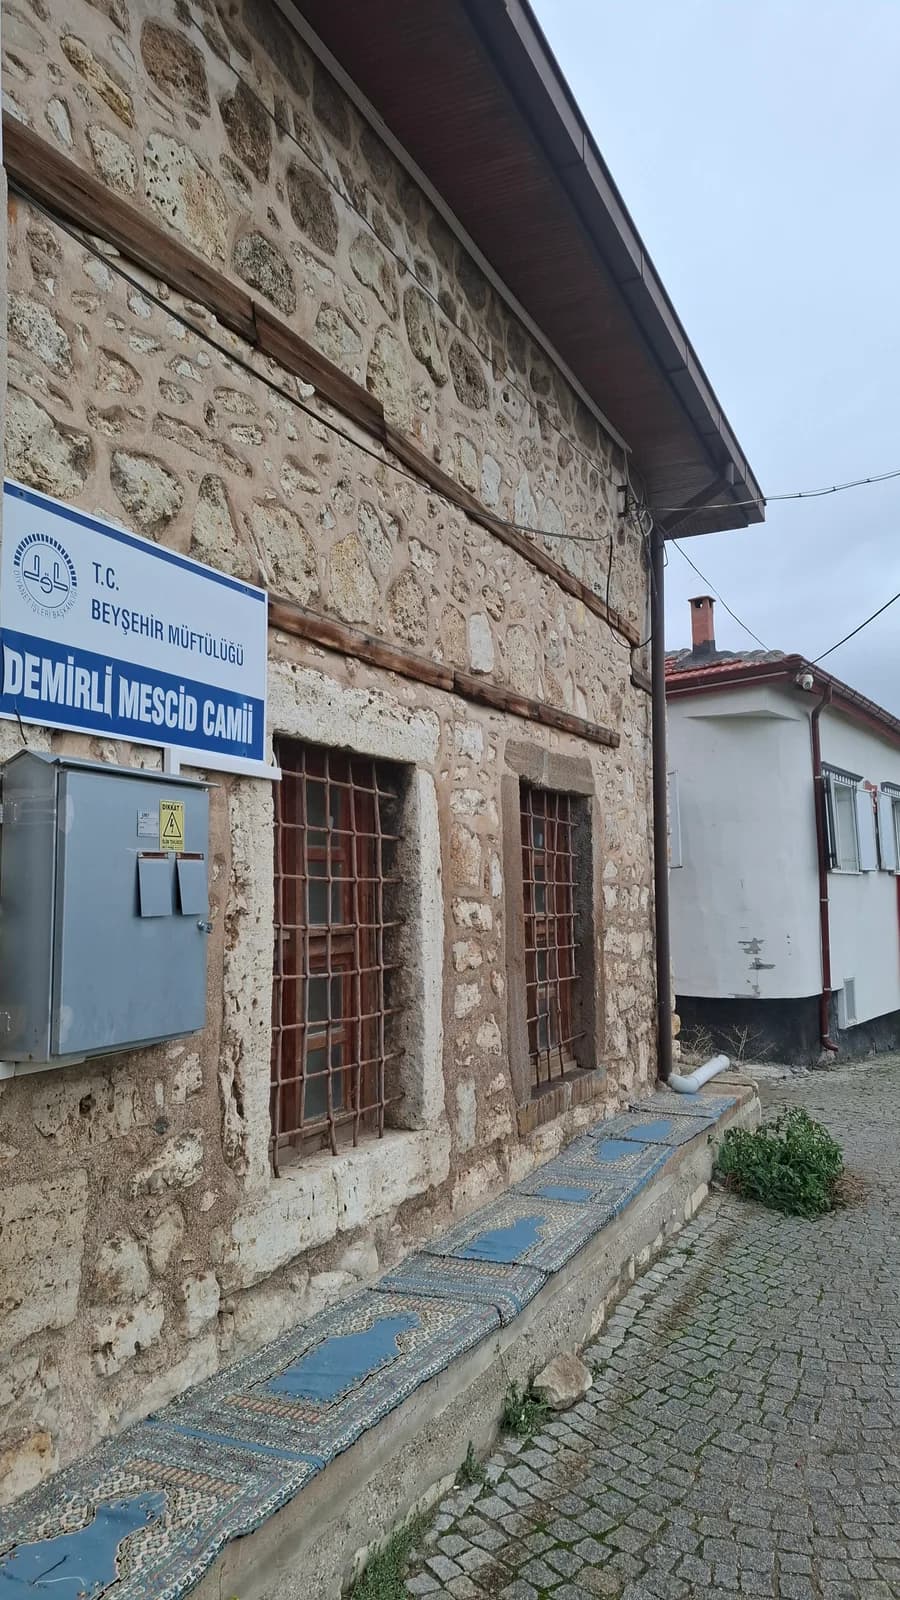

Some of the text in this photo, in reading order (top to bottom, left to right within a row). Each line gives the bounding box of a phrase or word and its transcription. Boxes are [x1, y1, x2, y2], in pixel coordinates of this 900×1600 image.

[92, 562, 119, 591] T.C.
[91, 599, 244, 666] BEYŞEHİR MÜFTÜLÜĞÜ
[3, 643, 253, 745] DEMİRLİ MESCİD CAMİİ
